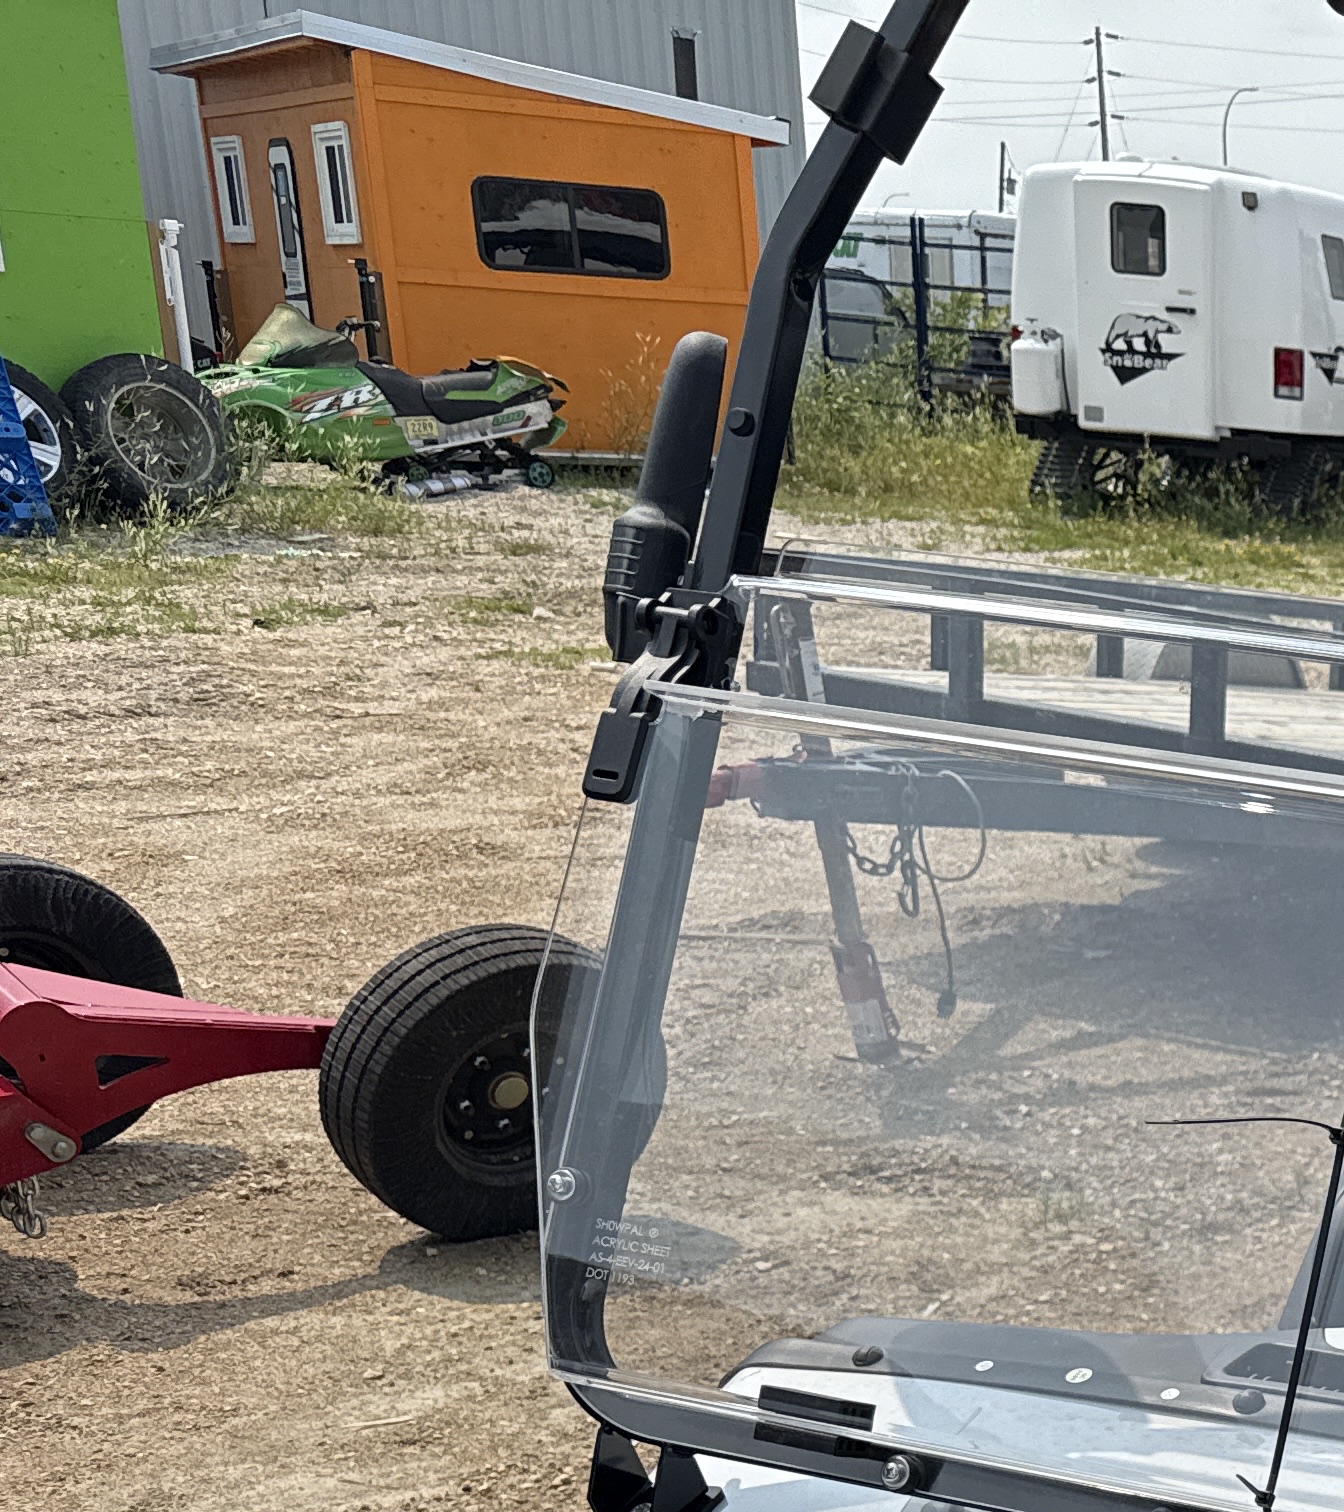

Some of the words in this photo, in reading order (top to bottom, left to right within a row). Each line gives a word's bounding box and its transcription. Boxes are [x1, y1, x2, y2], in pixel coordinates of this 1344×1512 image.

[595, 1218, 643, 1237] SHOWPAL
[592, 1235, 639, 1253] ACRYLIC
[640, 1242, 671, 1258] SHEET
[585, 1266, 609, 1281] DOT
[610, 1270, 635, 1286] 1193
